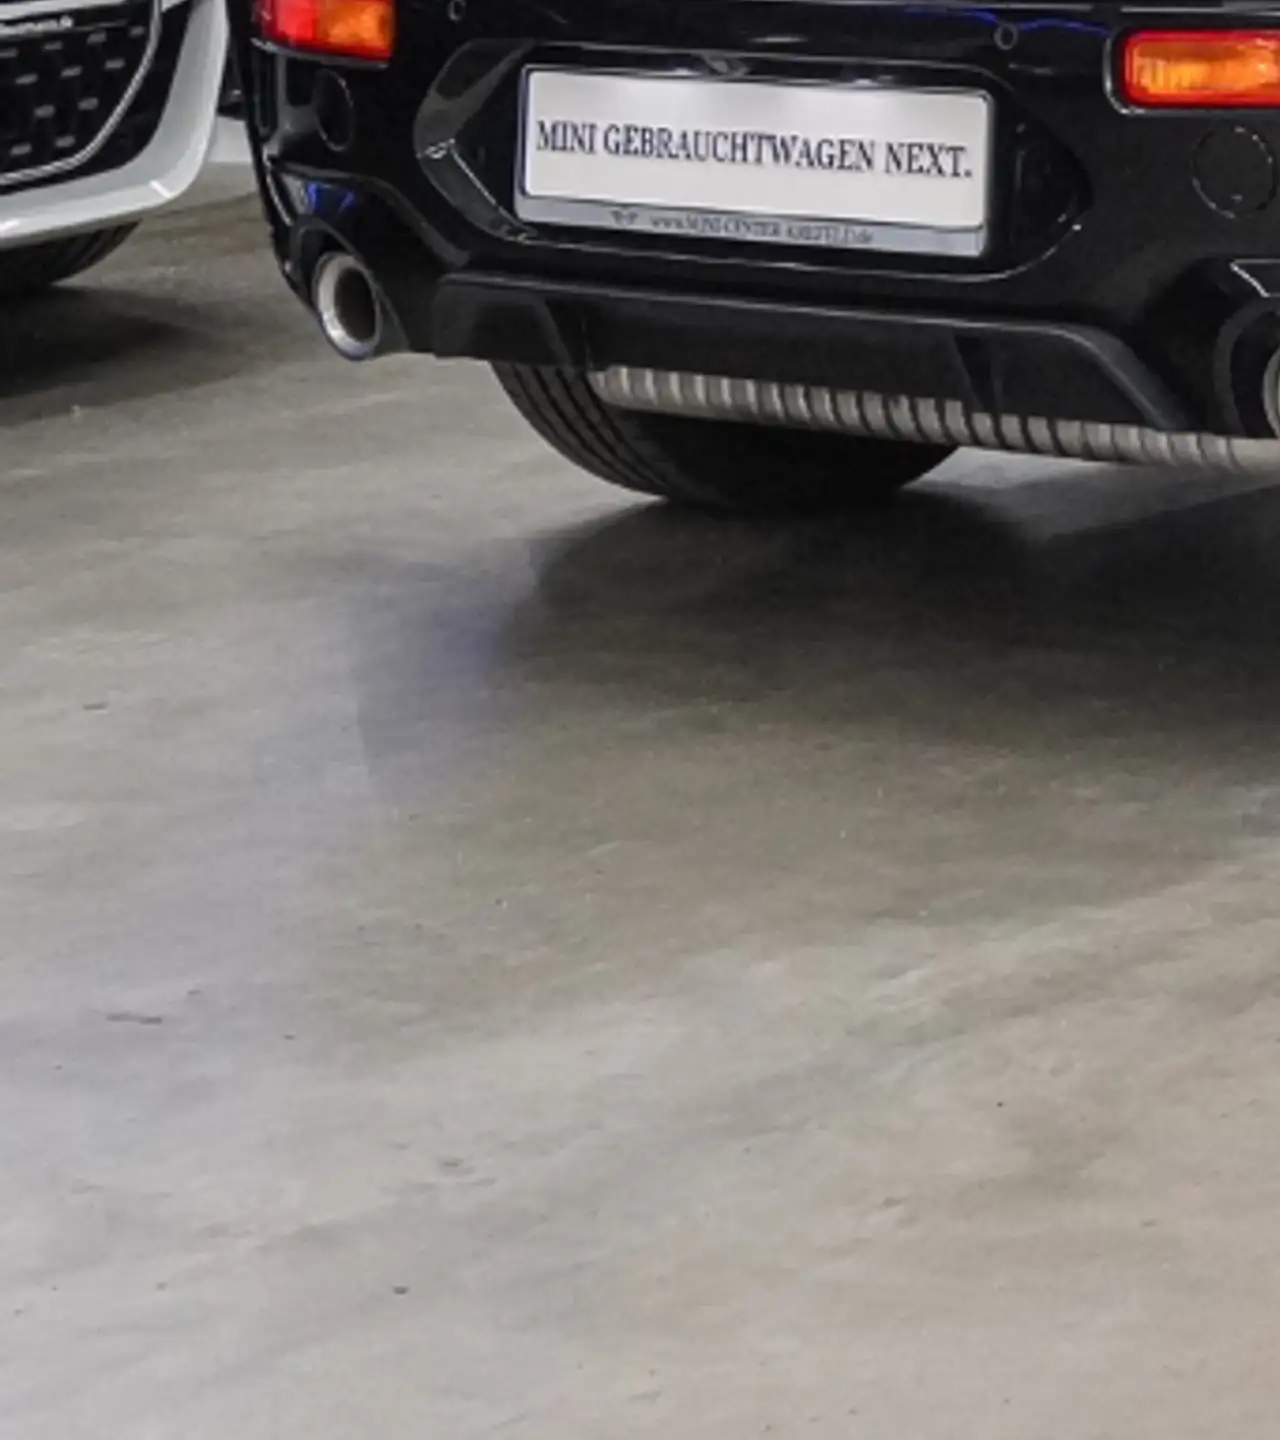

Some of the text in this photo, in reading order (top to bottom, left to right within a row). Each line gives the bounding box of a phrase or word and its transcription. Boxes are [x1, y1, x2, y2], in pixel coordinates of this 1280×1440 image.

[536, 120, 973, 179] MINI GEBRAUCHTWAGEN NEXT.
